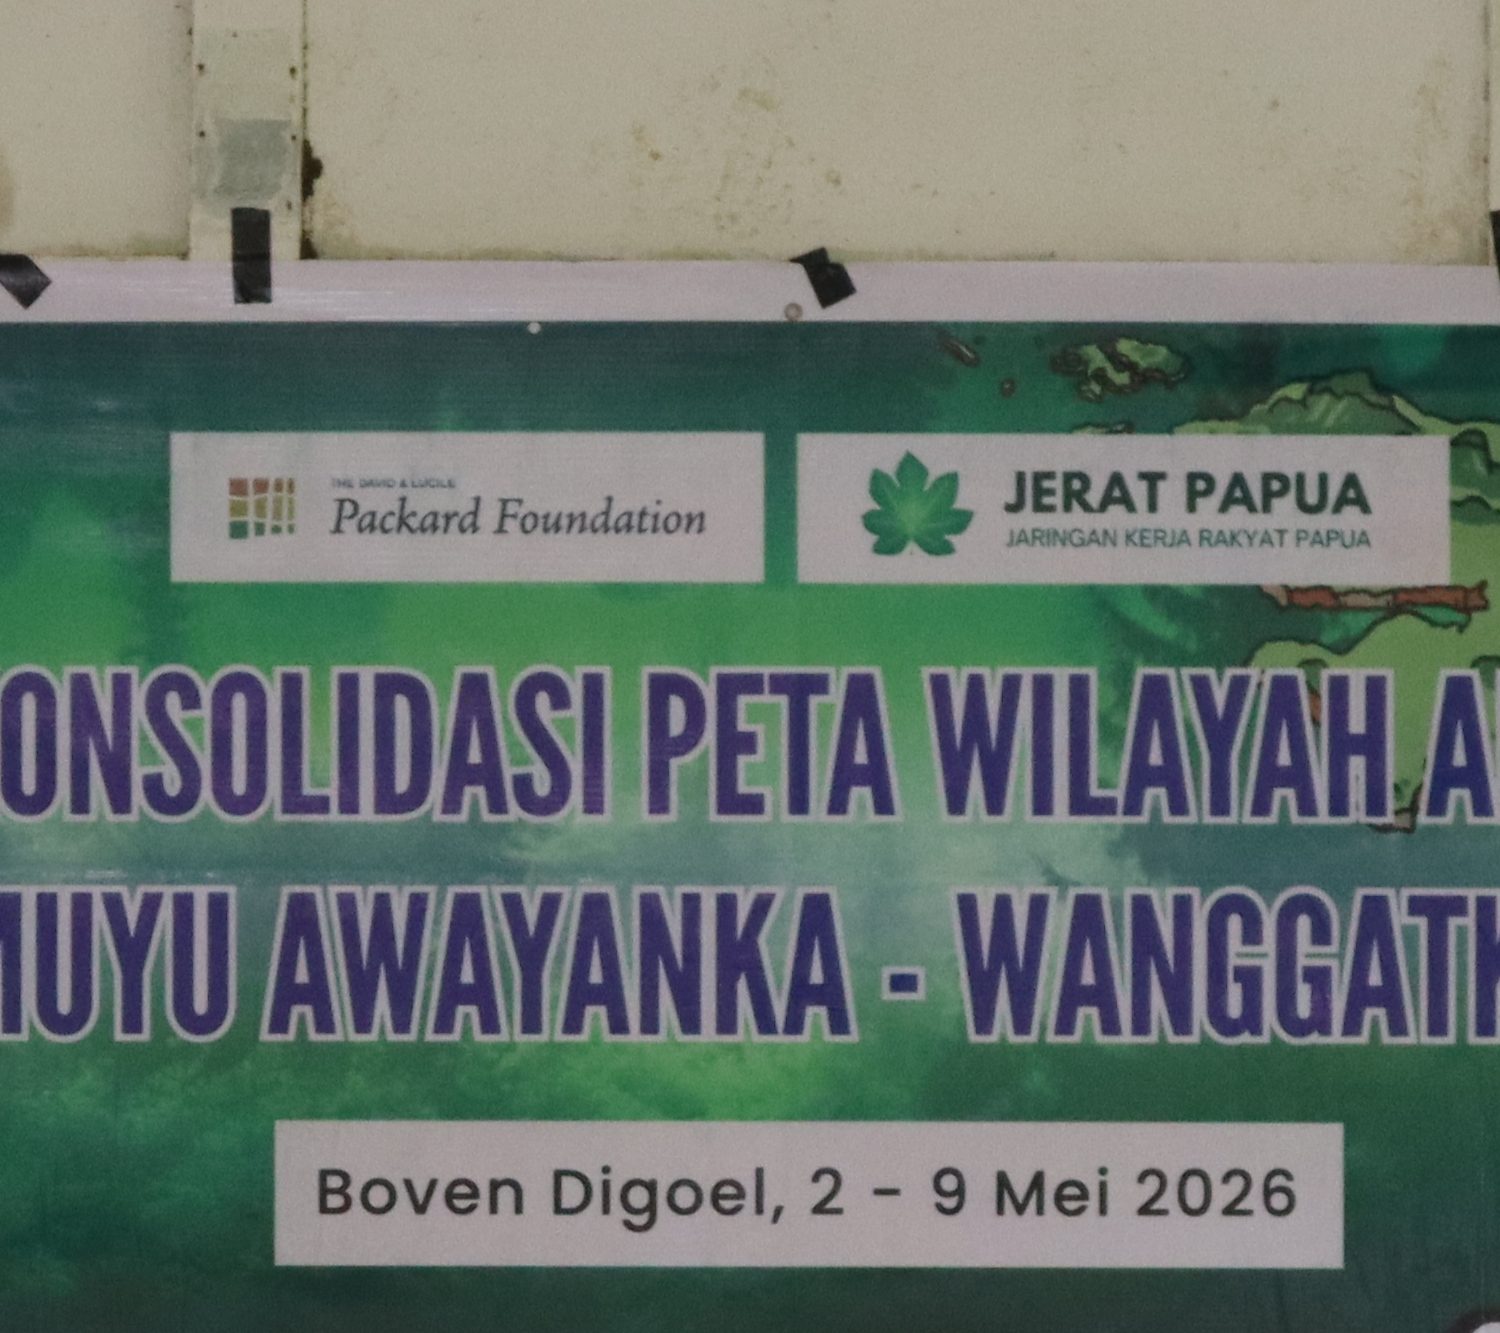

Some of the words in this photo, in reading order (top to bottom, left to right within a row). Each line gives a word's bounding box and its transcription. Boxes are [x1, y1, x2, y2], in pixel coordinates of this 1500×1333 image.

[359, 478, 396, 489] DAVID
[411, 478, 457, 489] LUCILE
[1004, 470, 1168, 515] JERAT
[1186, 470, 1373, 516] PAPUA
[330, 494, 482, 537] Packard
[492, 494, 707, 537] Foundation
[1006, 526, 1119, 550] JARINGAN
[1123, 526, 1193, 550] KERJA
[1197, 527, 1289, 550] RAKYAT
[1294, 527, 1373, 550] PAPUA
[645, 668, 898, 820] PETA
[929, 669, 1391, 822] WILAYAH
[267, 889, 854, 1041] AWAYANKA
[317, 1167, 525, 1217] Boven
[551, 1164, 785, 1234] Digoel,
[810, 1166, 845, 1217] 2
[931, 1166, 967, 1217] 9
[994, 1165, 1109, 1218] Mei
[1135, 1167, 1297, 1219] 2026
